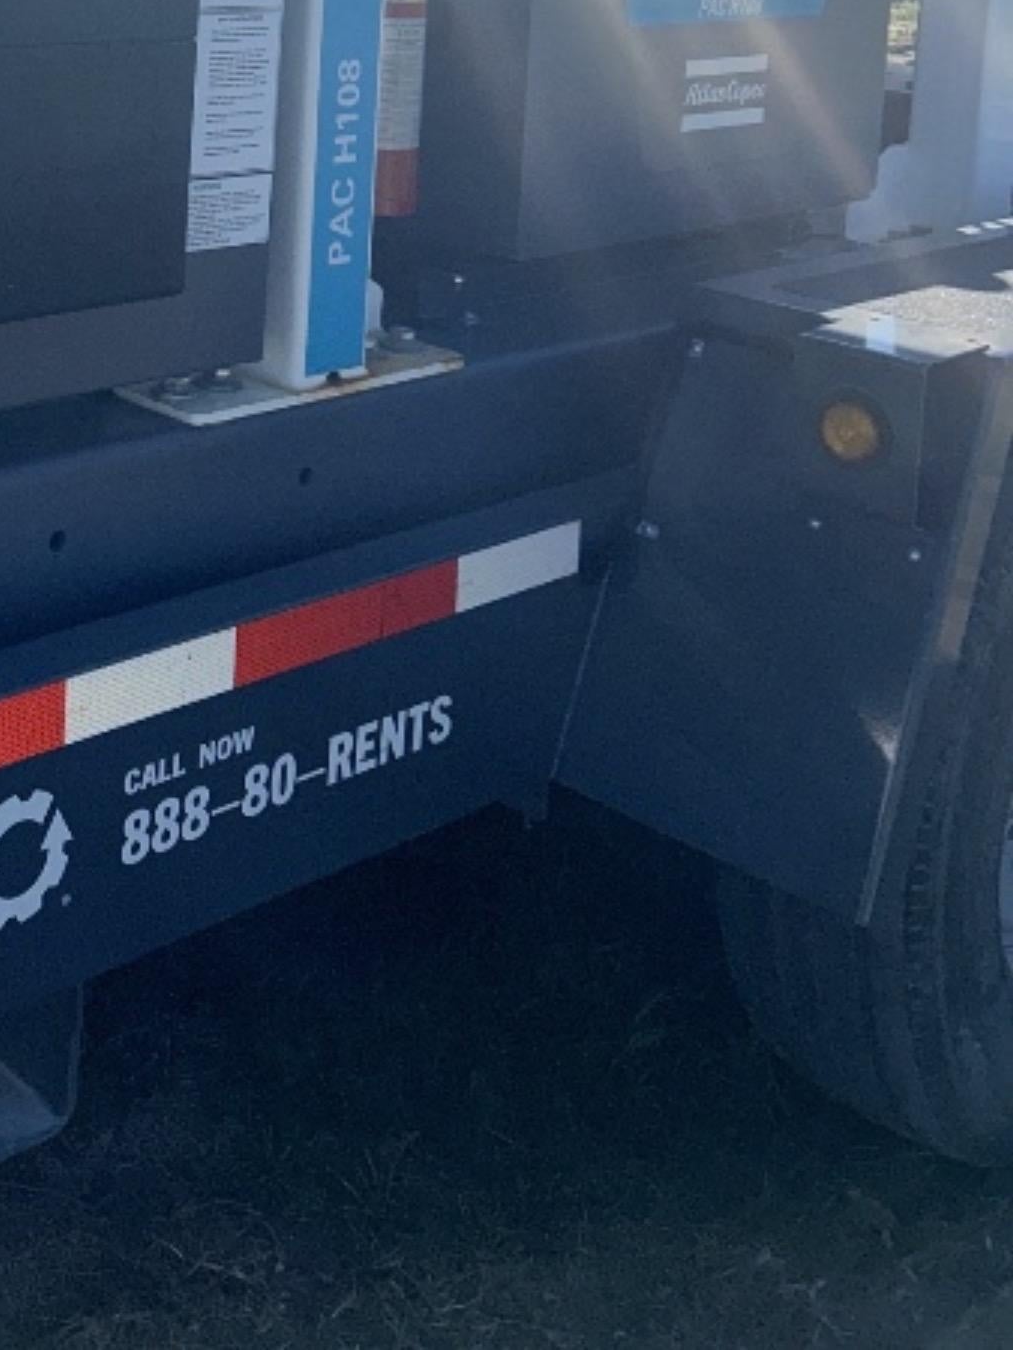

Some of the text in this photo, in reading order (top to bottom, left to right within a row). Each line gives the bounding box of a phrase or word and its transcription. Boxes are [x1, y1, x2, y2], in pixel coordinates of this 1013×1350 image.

[328, 57, 362, 267] PAC H108
[124, 726, 256, 796] CALL NOW
